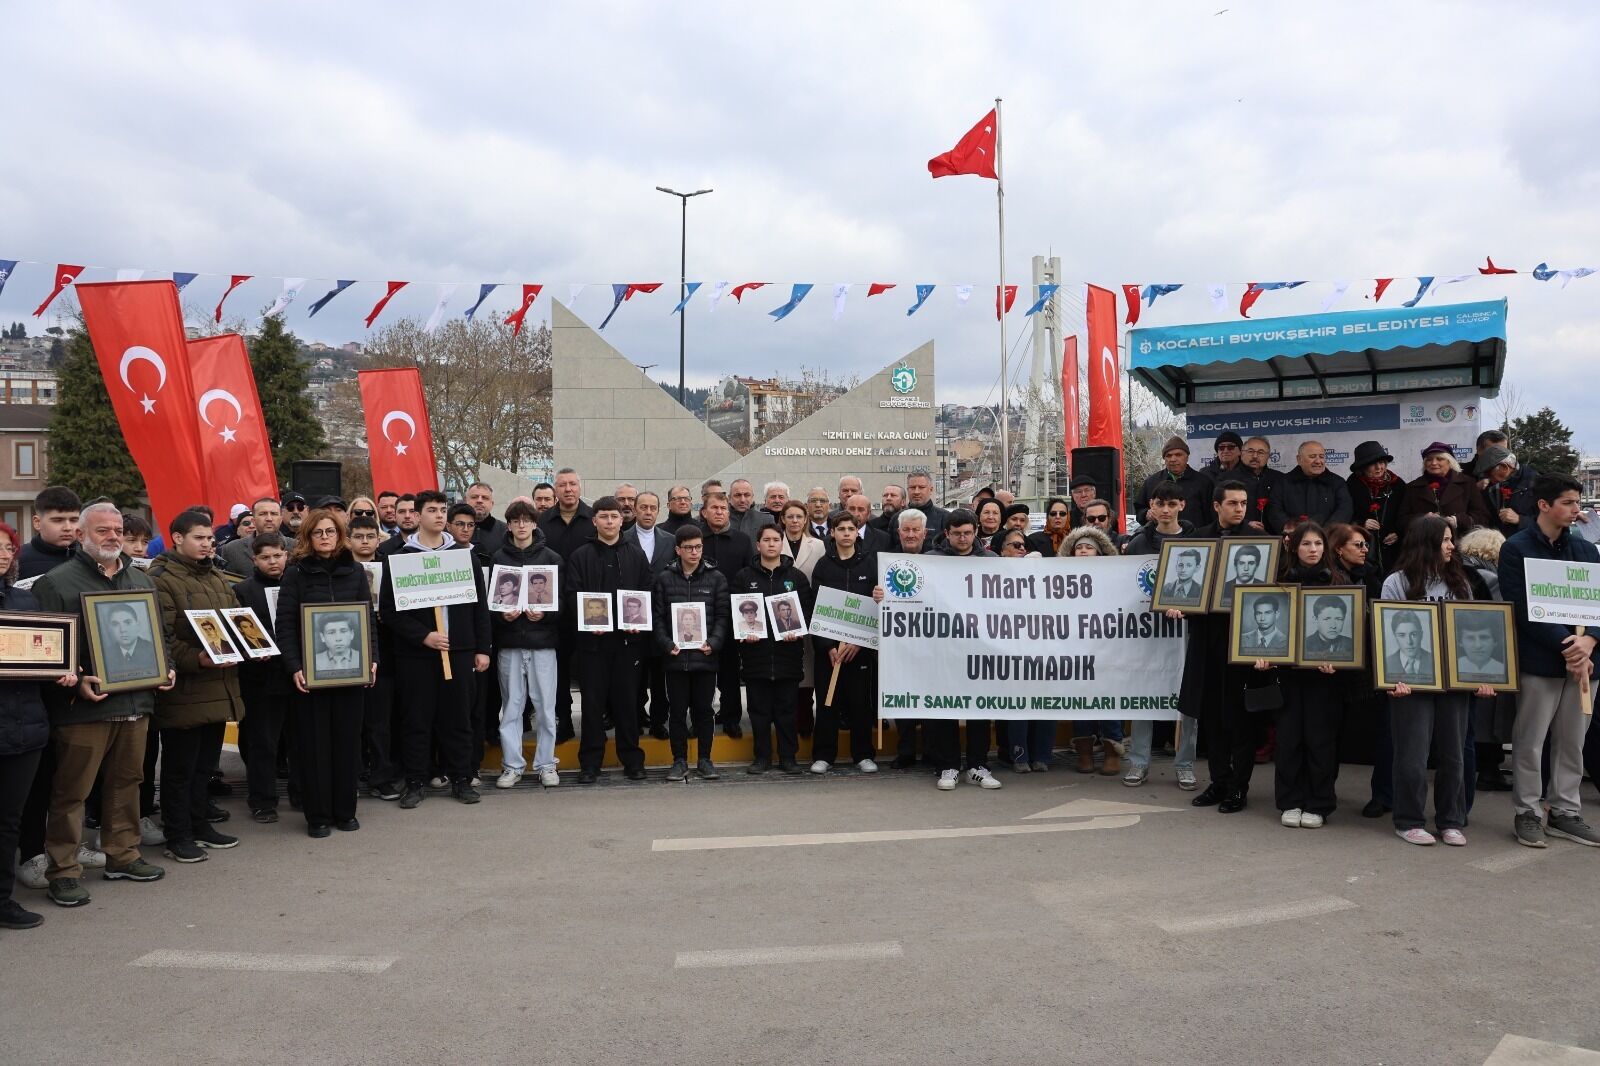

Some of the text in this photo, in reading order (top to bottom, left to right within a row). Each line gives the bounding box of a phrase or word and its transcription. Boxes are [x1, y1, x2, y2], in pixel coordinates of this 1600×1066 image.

[1156, 315, 1450, 351] KOCAELİ BÜYÜKŞEHİR BELEDİYESİ
[1198, 416, 1332, 431] KOCAELİ BÜYÜKŞEHİR
[863, 431, 876, 440] EN
[877, 431, 902, 440] KARA
[765, 445, 807, 456] ÜSKÜDAR
[808, 447, 844, 456] VAPURU
[845, 445, 872, 456] DENİZ
[964, 573, 1093, 599] 1 Mart 1958
[882, 606, 979, 639] ÜSKÜDAR
[986, 613, 1070, 640] VAPURU
[966, 654, 1096, 681] UNUTMADIK
[881, 691, 1179, 710] İZMİT SANAT OKULU MEZUNLARI DERNEĞ
